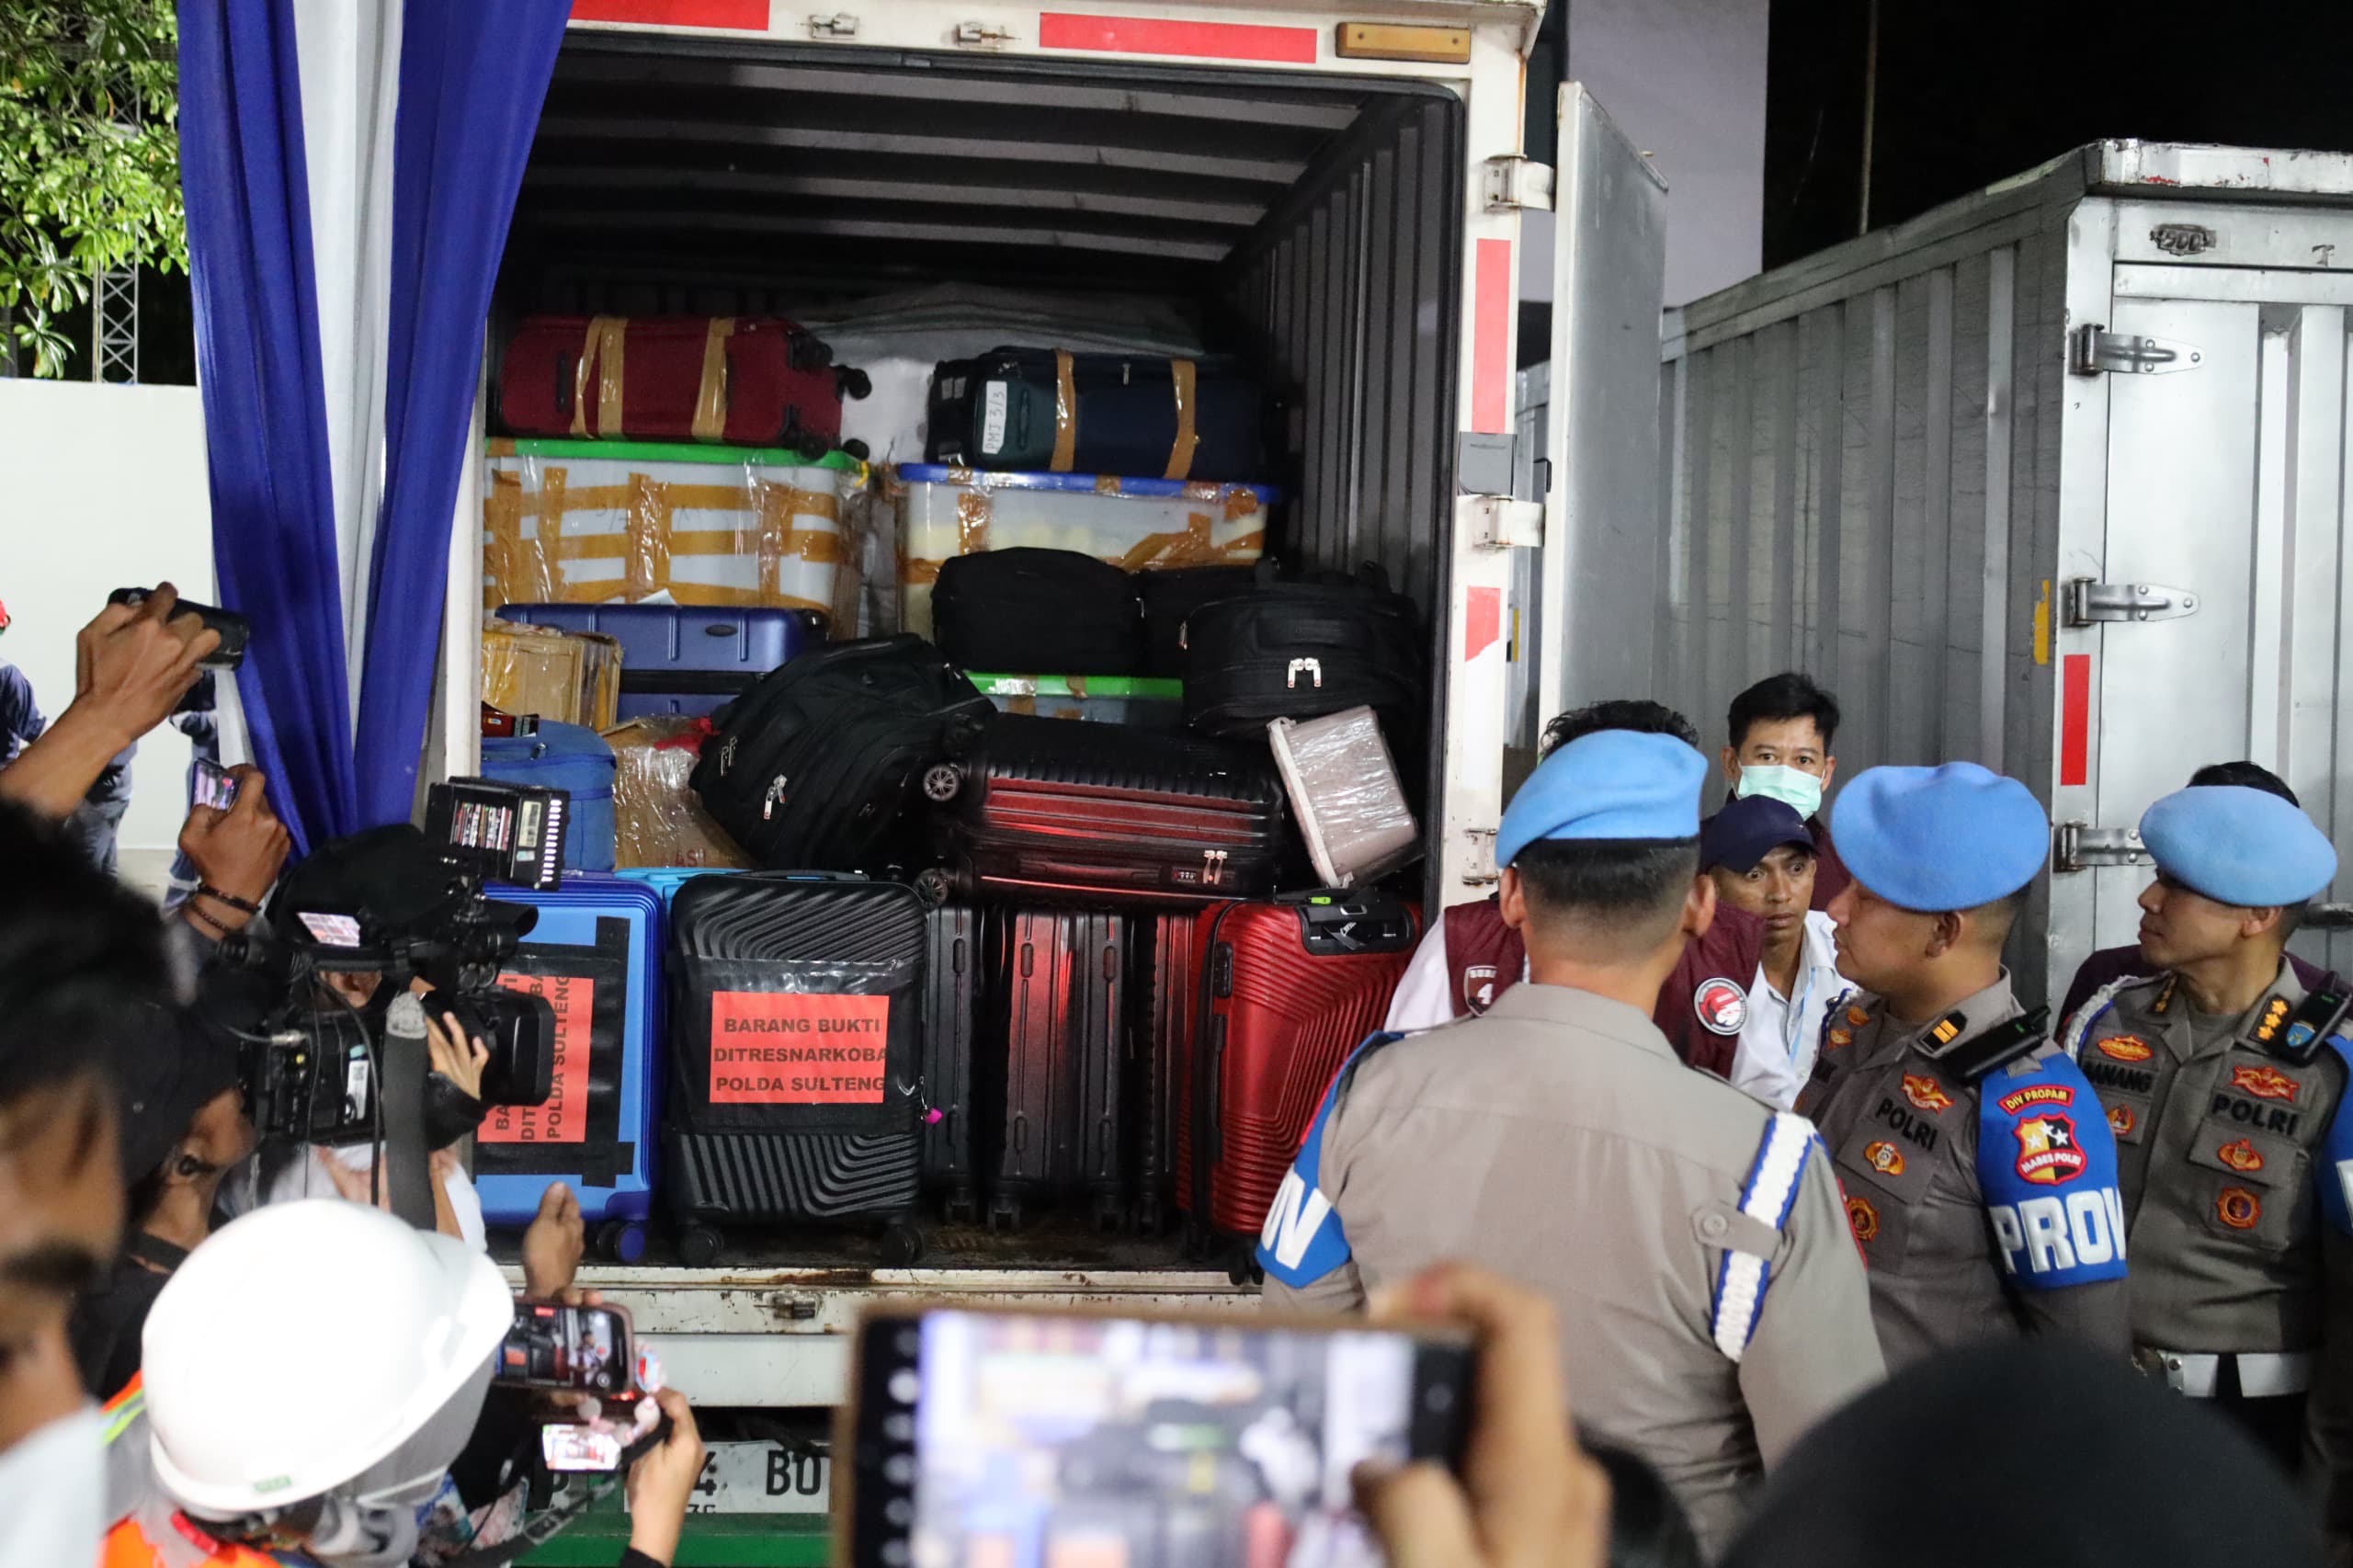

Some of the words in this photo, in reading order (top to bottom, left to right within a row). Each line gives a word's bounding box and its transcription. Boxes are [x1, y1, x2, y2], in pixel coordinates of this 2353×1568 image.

[1477, 983, 1494, 1005] 4
[724, 1018, 811, 1034] BARANG
[818, 1018, 881, 1033] BUKTI
[714, 1048, 888, 1062] DITRESNARKOBA
[716, 1077, 784, 1091] POLDA
[791, 1077, 886, 1091] SULTENG
[547, 1072, 565, 1139] POLDA
[2006, 1095, 2024, 1110] DIV
[2025, 1088, 2067, 1102] PROPAM
[1876, 1097, 1938, 1152] POLRI
[2211, 1094, 2301, 1136] POLRI
[2021, 1152, 2054, 1174] MABES
[2054, 1152, 2082, 1166] POLRI
